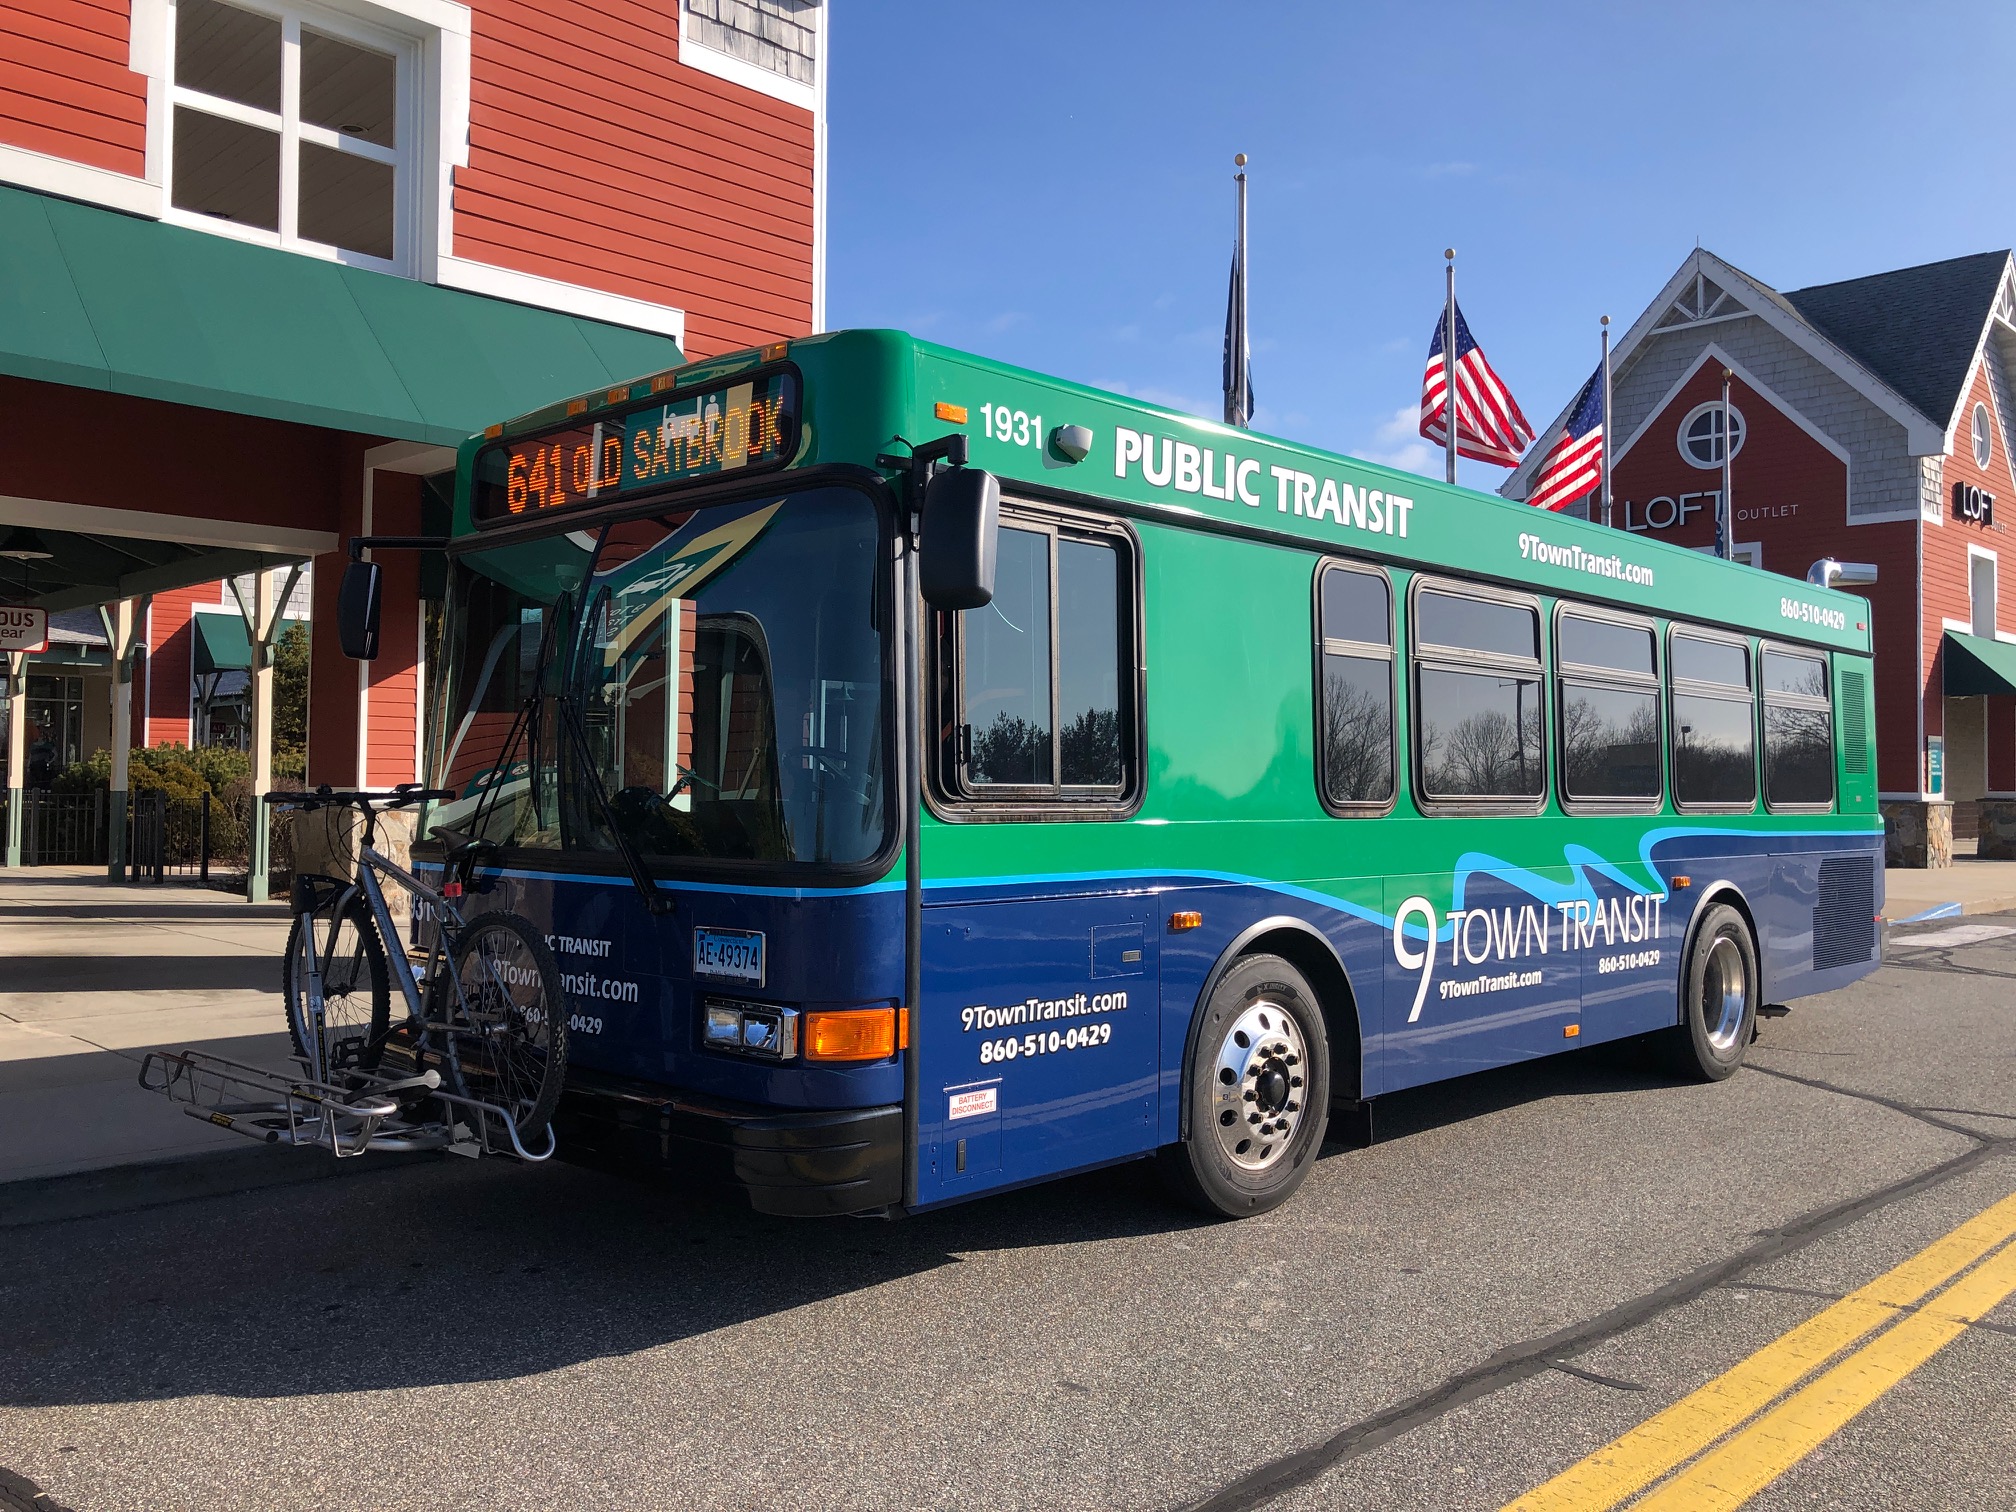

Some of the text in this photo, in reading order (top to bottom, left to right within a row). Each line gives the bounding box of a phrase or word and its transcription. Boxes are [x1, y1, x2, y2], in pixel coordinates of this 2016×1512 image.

[980, 402, 1042, 450] 1931
[508, 445, 565, 513] 641
[573, 438, 622, 493] OLD
[1114, 426, 1414, 539] PUBLIC TRANSIT
[1626, 490, 1798, 530] LOFT OUTLET
[1963, 481, 1996, 525] LOFT
[1518, 532, 1654, 587] 9TownTransit.com
[1780, 597, 1845, 630] 860-510-0429
[558, 936, 612, 957] TRANSIT
[1393, 893, 1665, 1023] 9 TOWN TRANSIT
[1598, 949, 1661, 974] 860-510-0429
[1439, 969, 1542, 1000] 9TownTransit.com
[961, 991, 1128, 1031] 9TownTransit.com
[979, 1023, 1112, 1064] 860-510-0429
[952, 1100, 993, 1115] DISCONNECT
[958, 1092, 987, 1105] BATTERY
